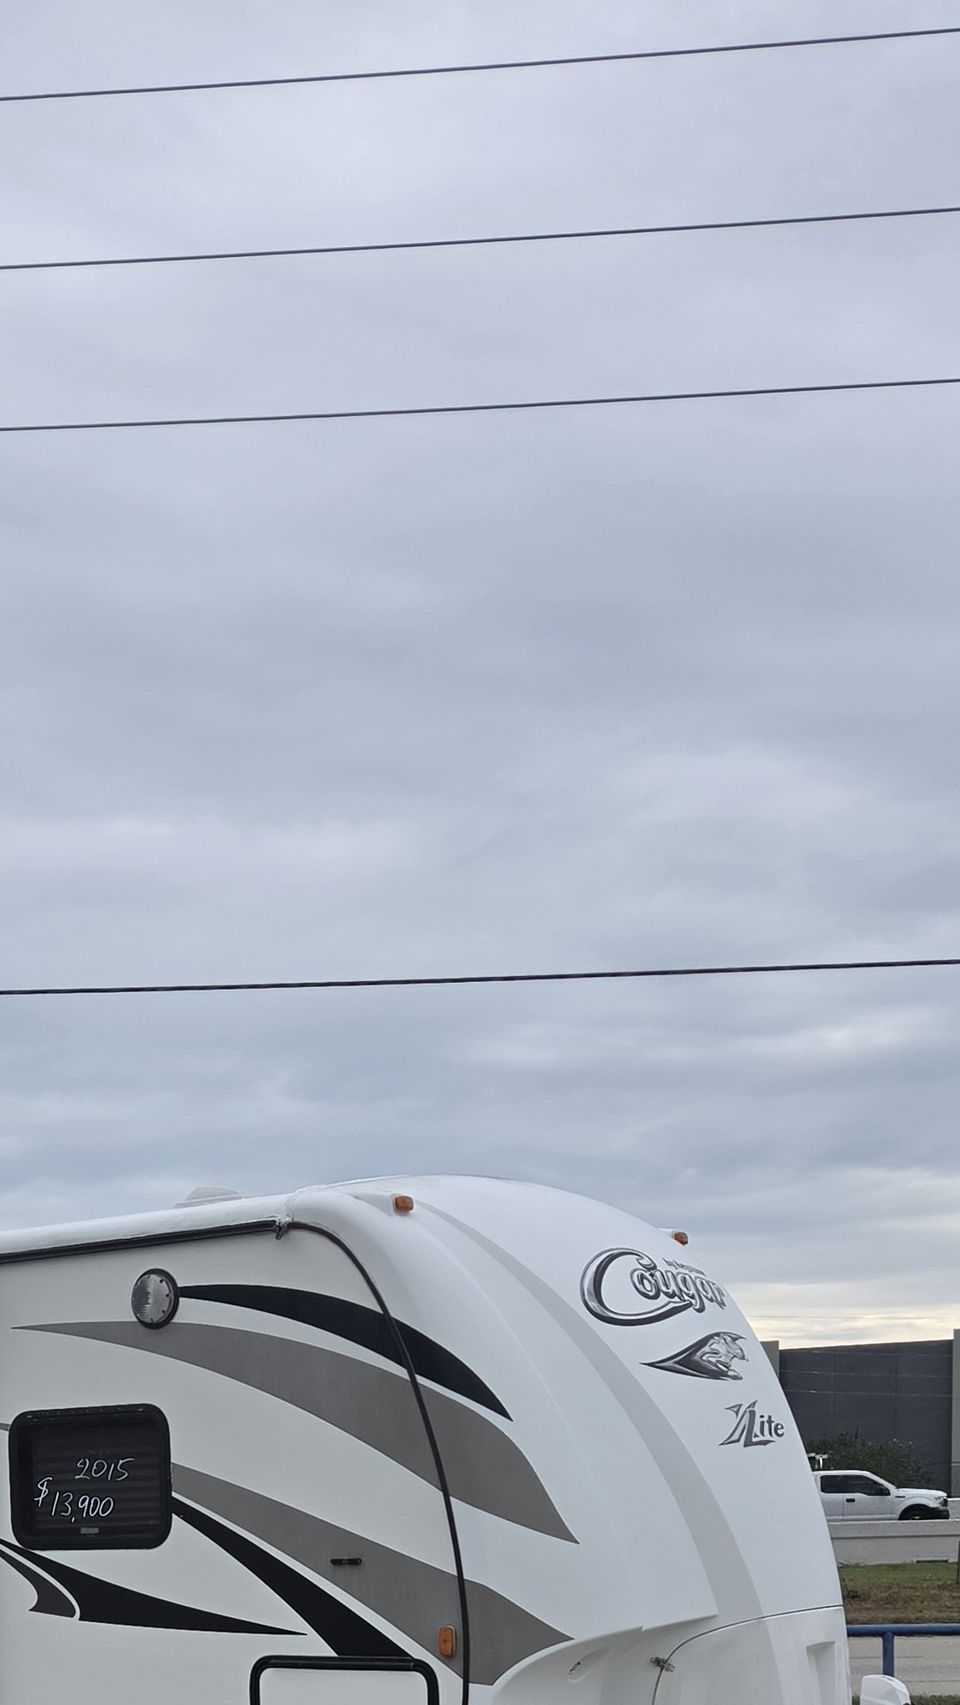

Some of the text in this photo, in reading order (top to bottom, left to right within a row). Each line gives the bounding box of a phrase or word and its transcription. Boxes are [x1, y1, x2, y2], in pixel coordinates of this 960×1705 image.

[580, 1247, 726, 1326] Cougar
[74, 1458, 135, 1481] 2015
[34, 1477, 114, 1523] $13,900
